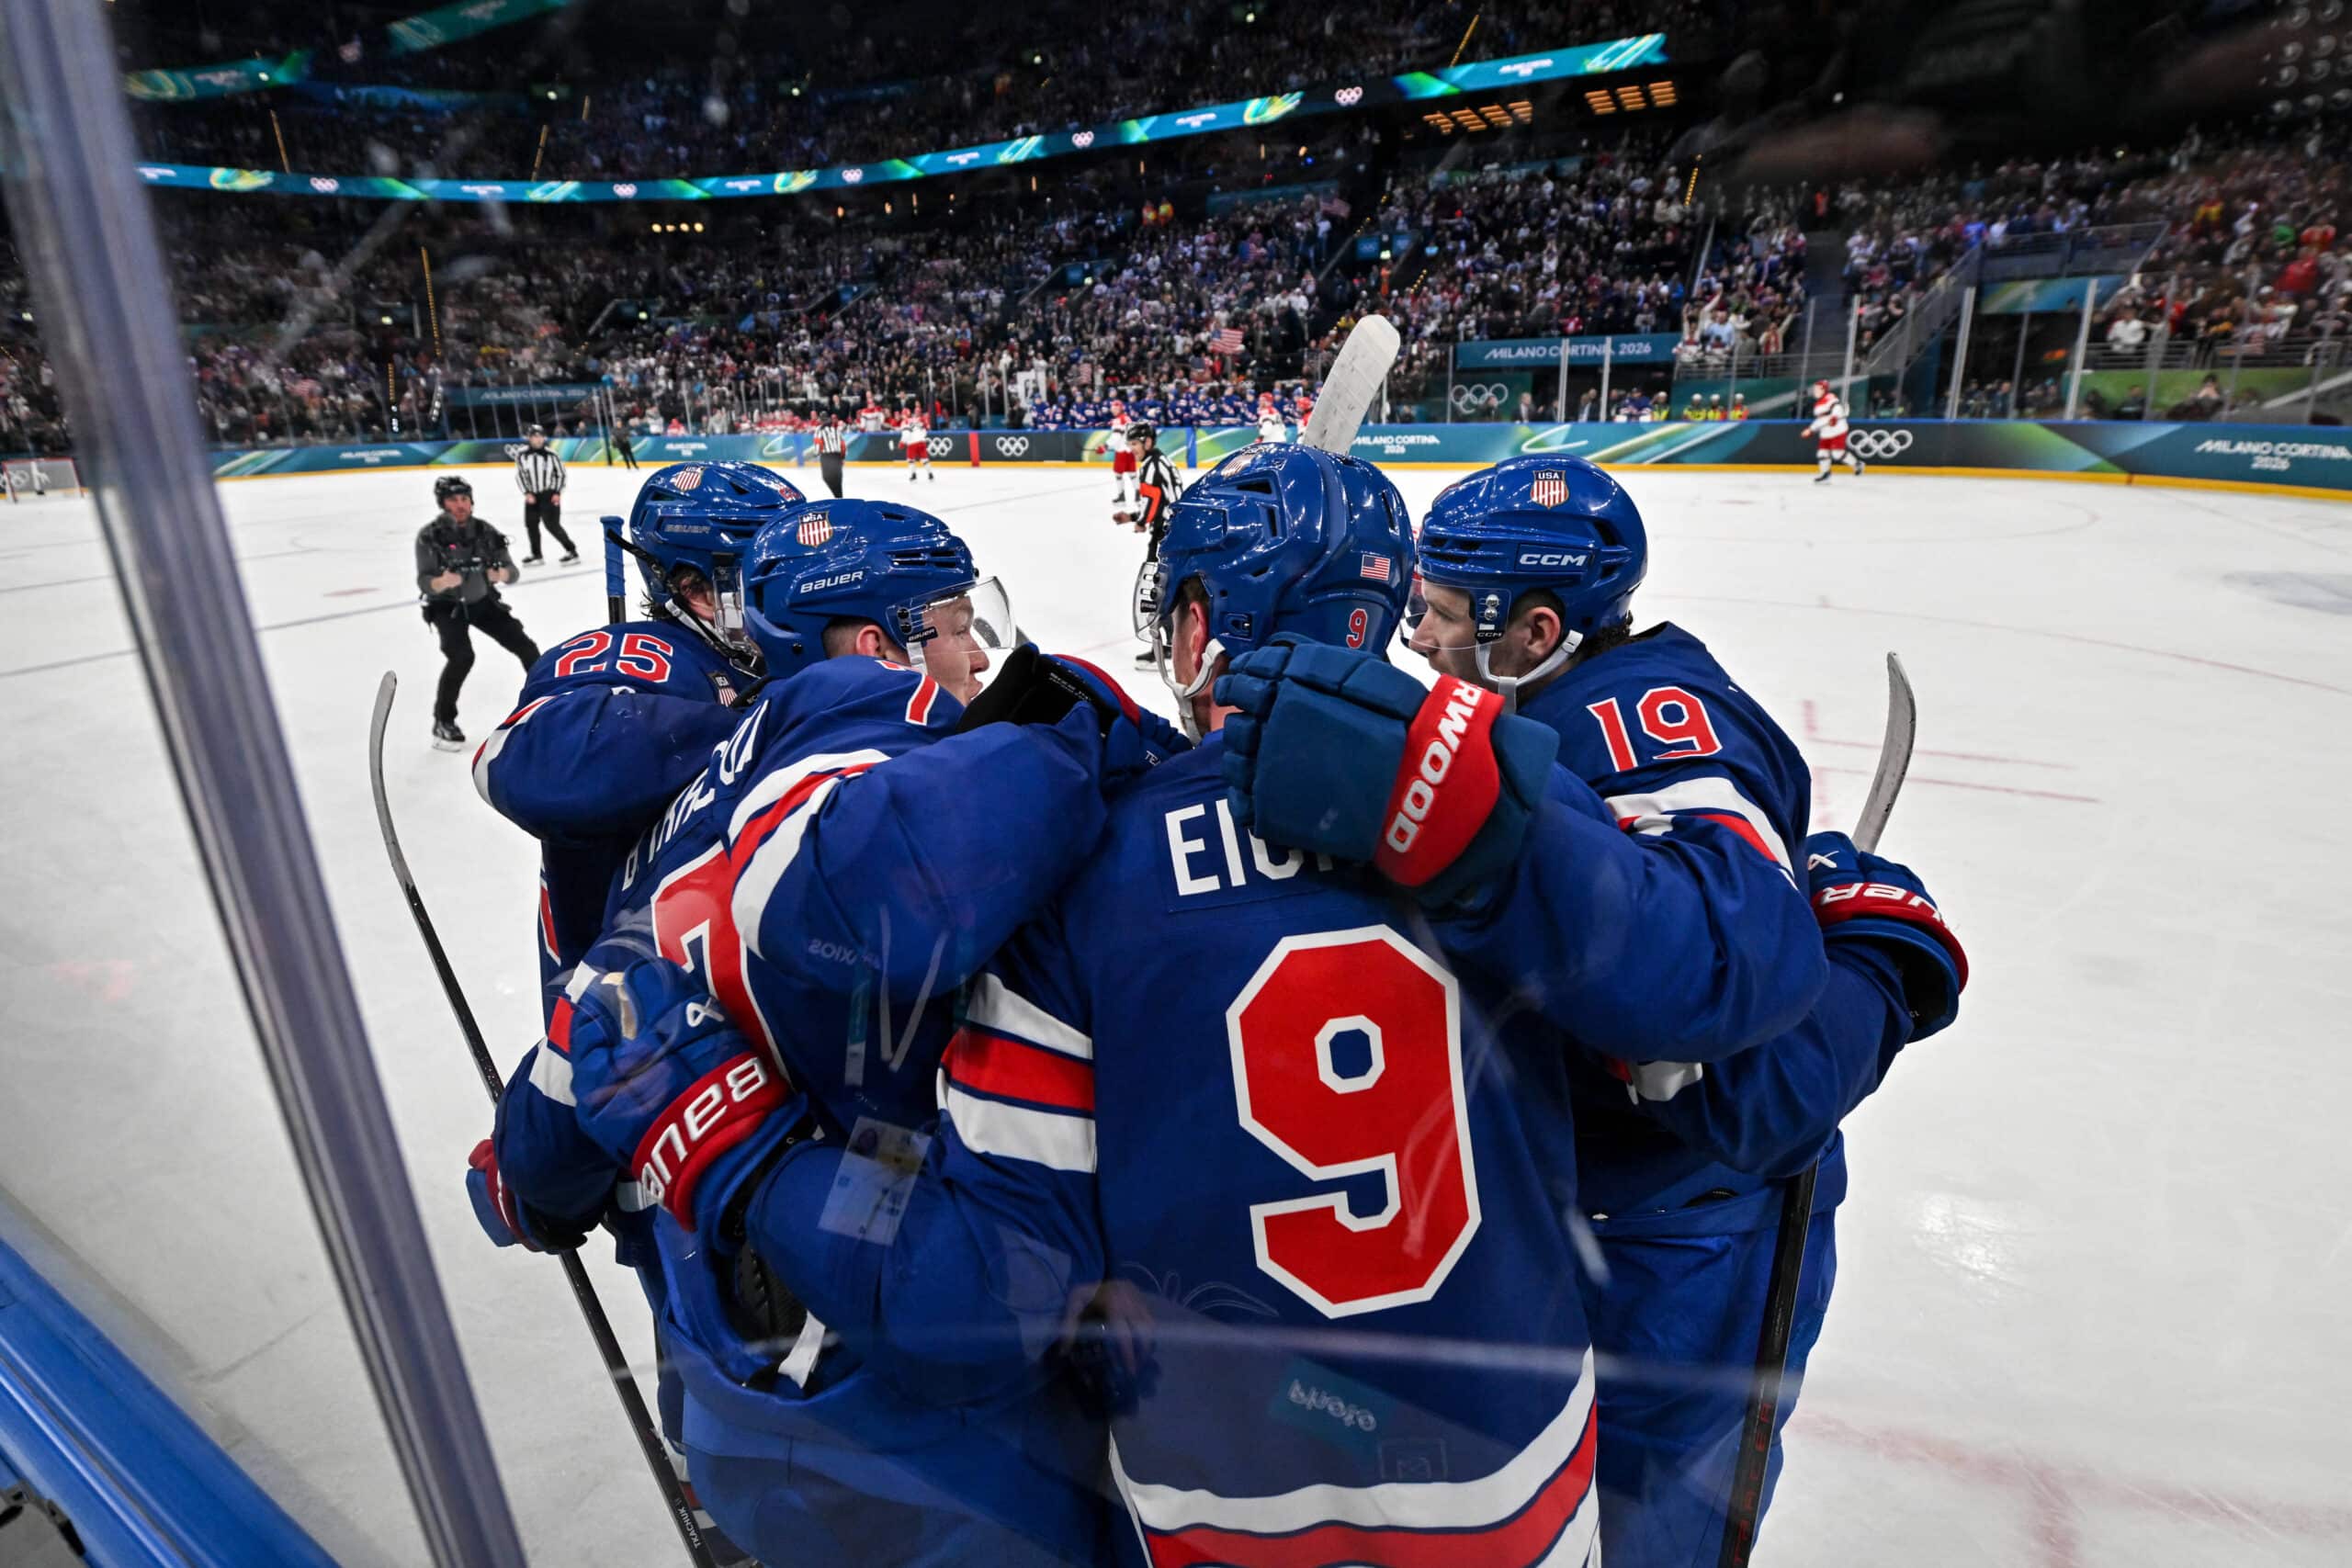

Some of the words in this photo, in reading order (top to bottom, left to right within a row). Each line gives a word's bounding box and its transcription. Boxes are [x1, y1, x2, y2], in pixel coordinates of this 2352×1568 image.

[1485, 346, 1546, 360] MILANO
[1549, 344, 1615, 357] CRTIN
[1619, 342, 1652, 355] 2026
[2194, 439, 2273, 456] MILANO
[2274, 442, 2352, 460] CORTINA
[802, 513, 823, 523] USA
[1520, 554, 1588, 567] CCM
[800, 570, 864, 594] BAUER
[1346, 608, 1368, 649] 9
[554, 631, 673, 683] 25
[1586, 686, 1723, 773] 19
[1385, 680, 1485, 854] RWOOD
[1225, 923, 1482, 1319] 9
